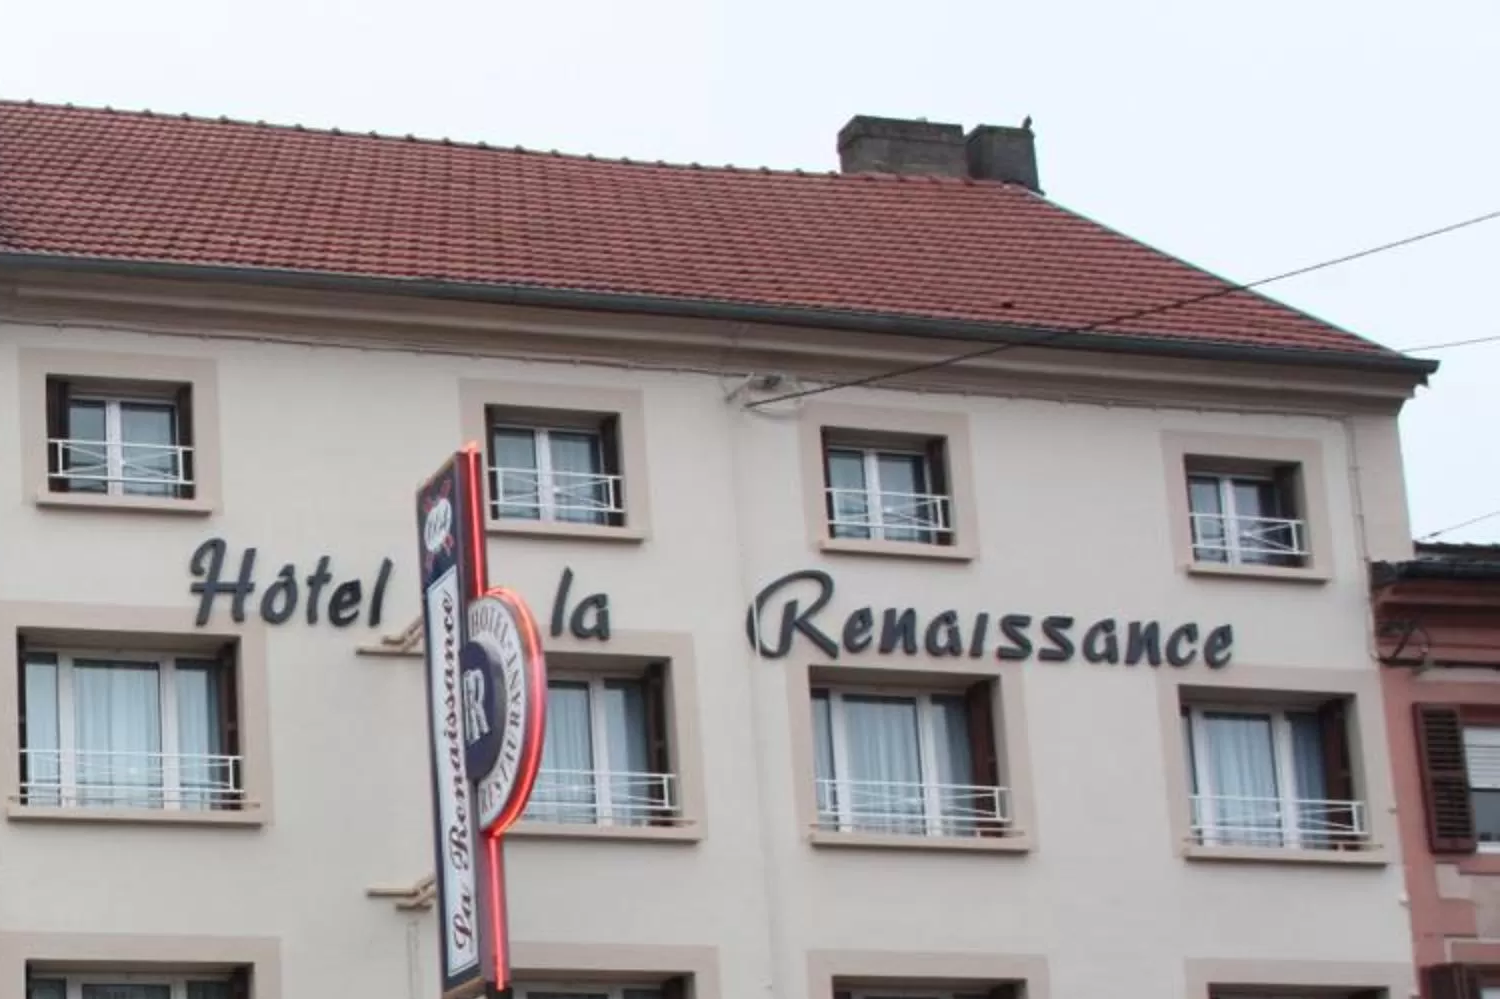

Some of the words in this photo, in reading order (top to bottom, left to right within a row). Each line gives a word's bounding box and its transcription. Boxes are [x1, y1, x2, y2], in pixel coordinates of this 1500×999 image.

[190, 537, 393, 628] Hôtel
[550, 567, 611, 640] la
[746, 569, 1234, 668] Renaissance
[440, 588, 472, 871] Renaissance
